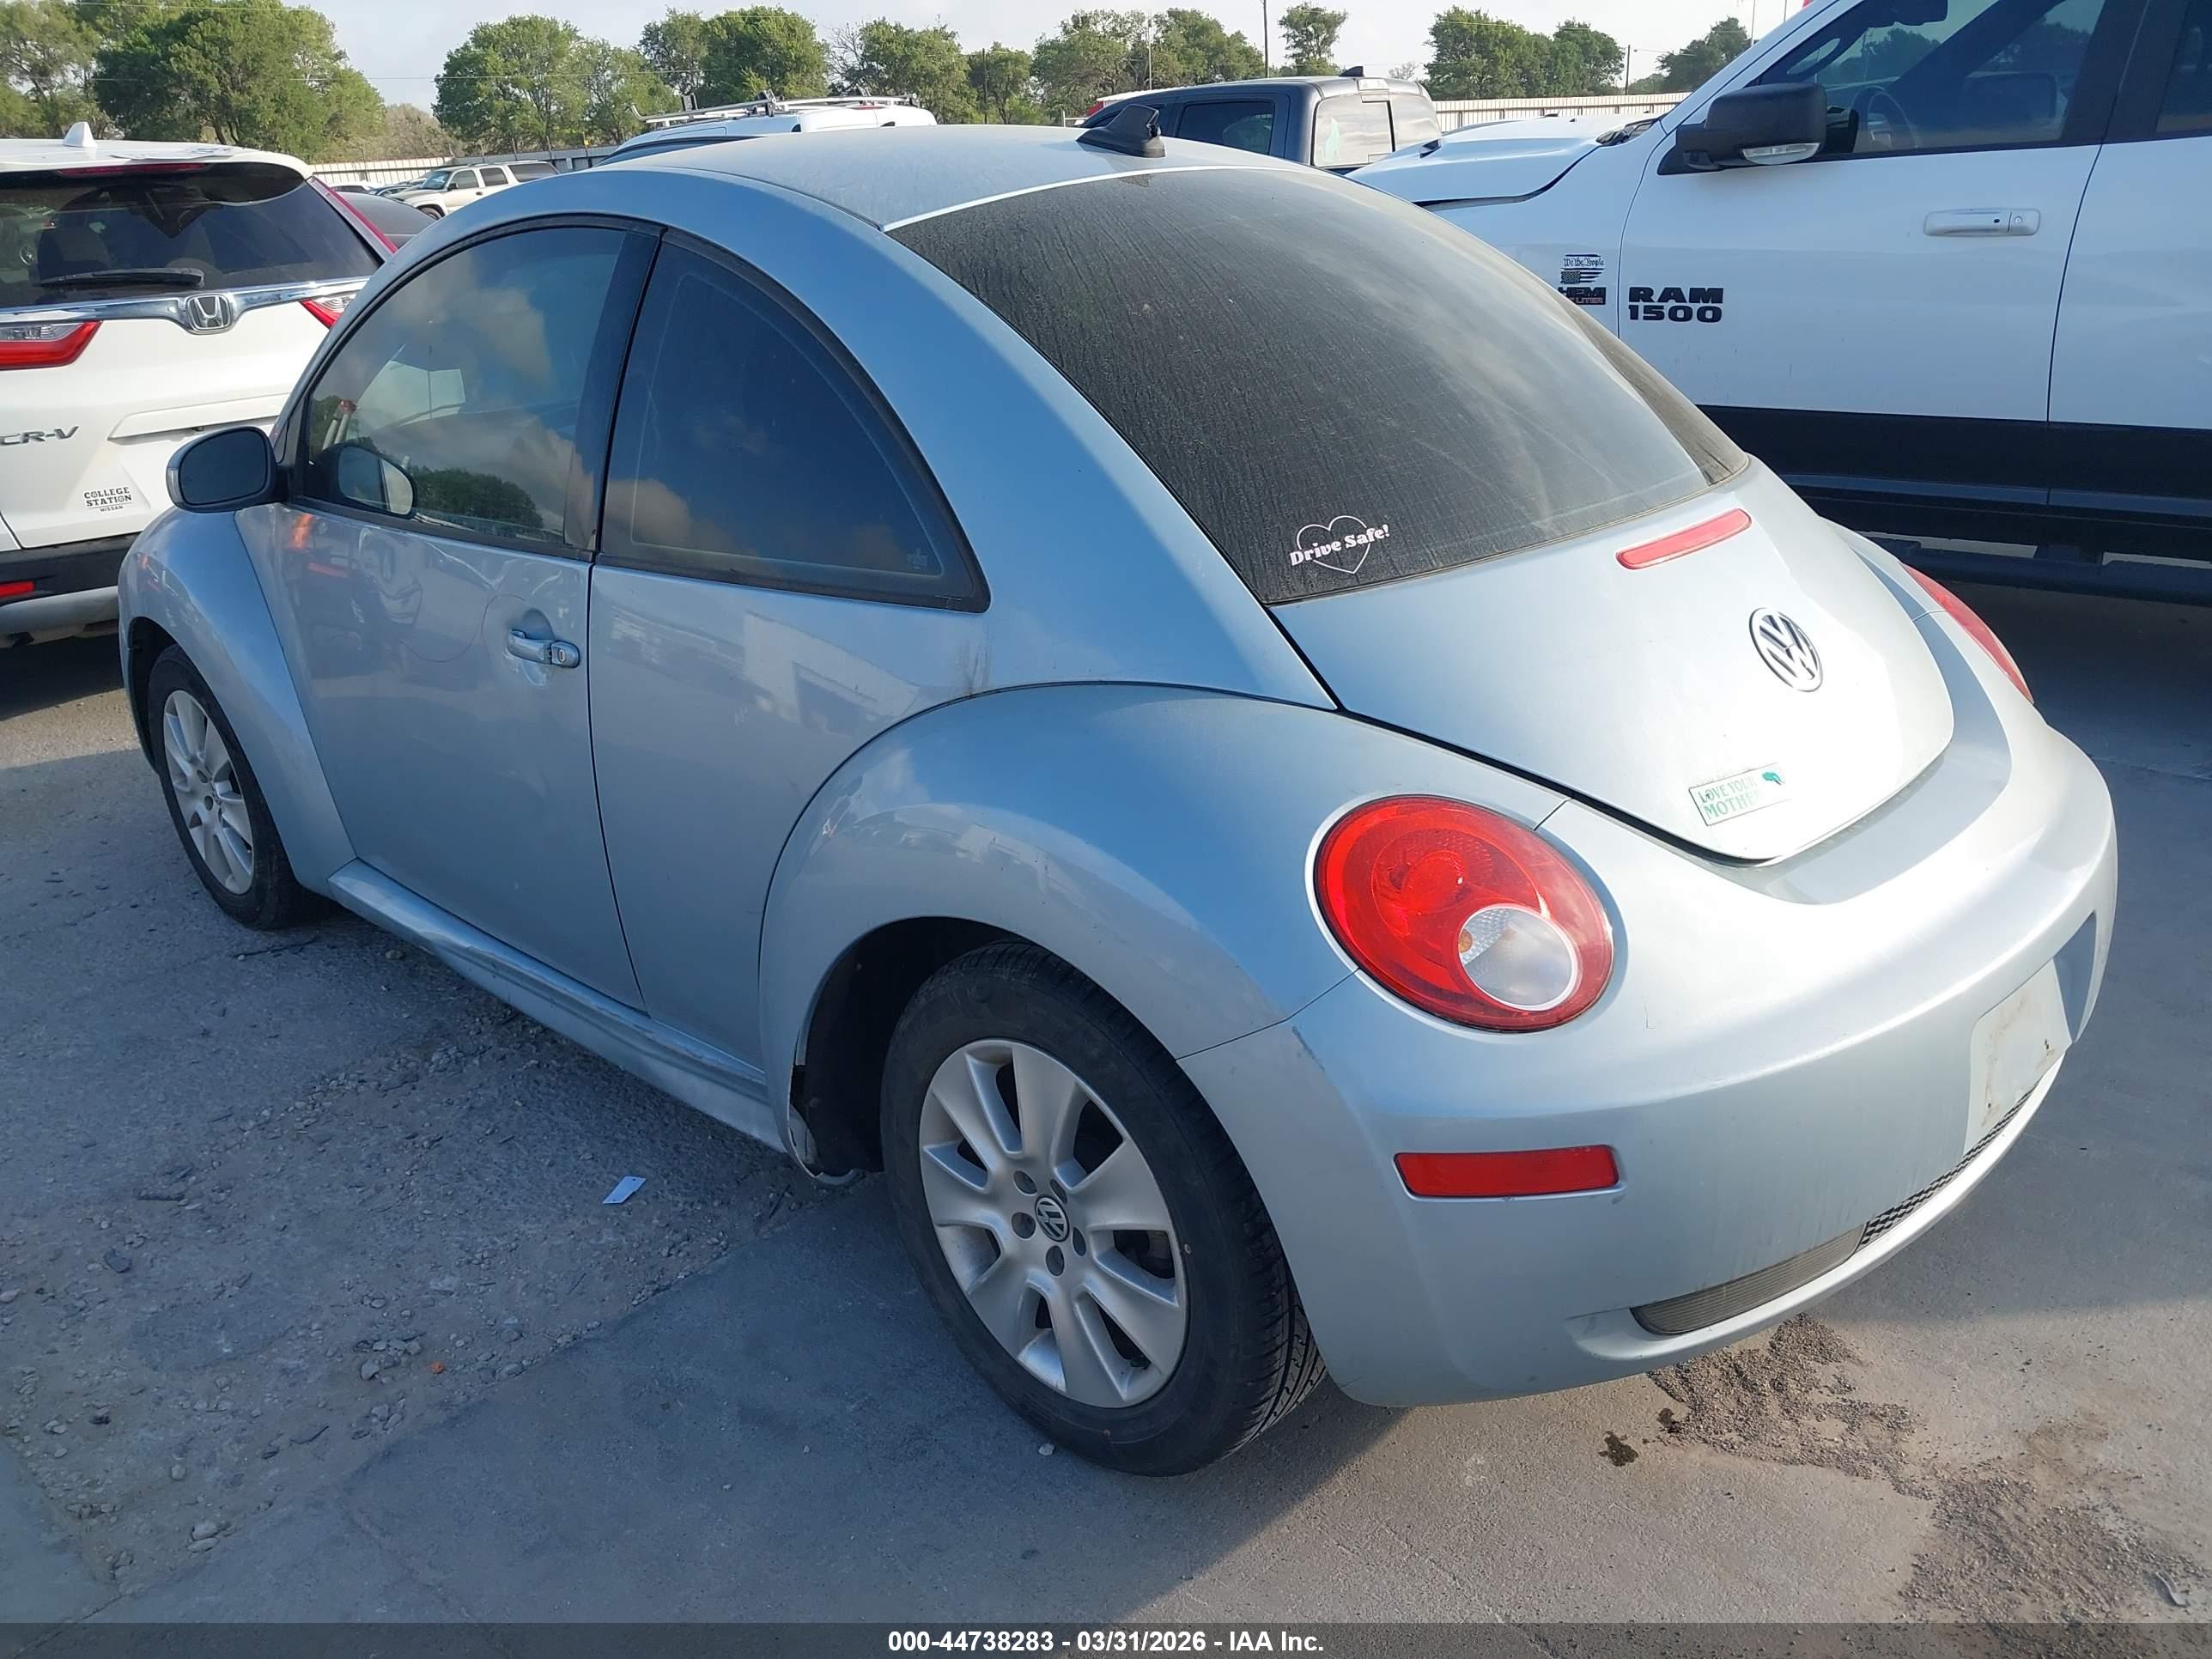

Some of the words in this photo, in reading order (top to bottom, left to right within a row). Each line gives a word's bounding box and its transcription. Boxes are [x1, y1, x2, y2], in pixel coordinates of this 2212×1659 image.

[1629, 287, 1723, 303] RAM
[1628, 305, 1723, 323] 1500
[0, 426, 79, 446] CR-V
[84, 487, 130, 499] COLLEGE
[86, 495, 132, 507] STATION
[1290, 543, 1342, 566] Drive
[1344, 524, 1390, 549] Safe!
[1698, 784, 1729, 803] LOVE
